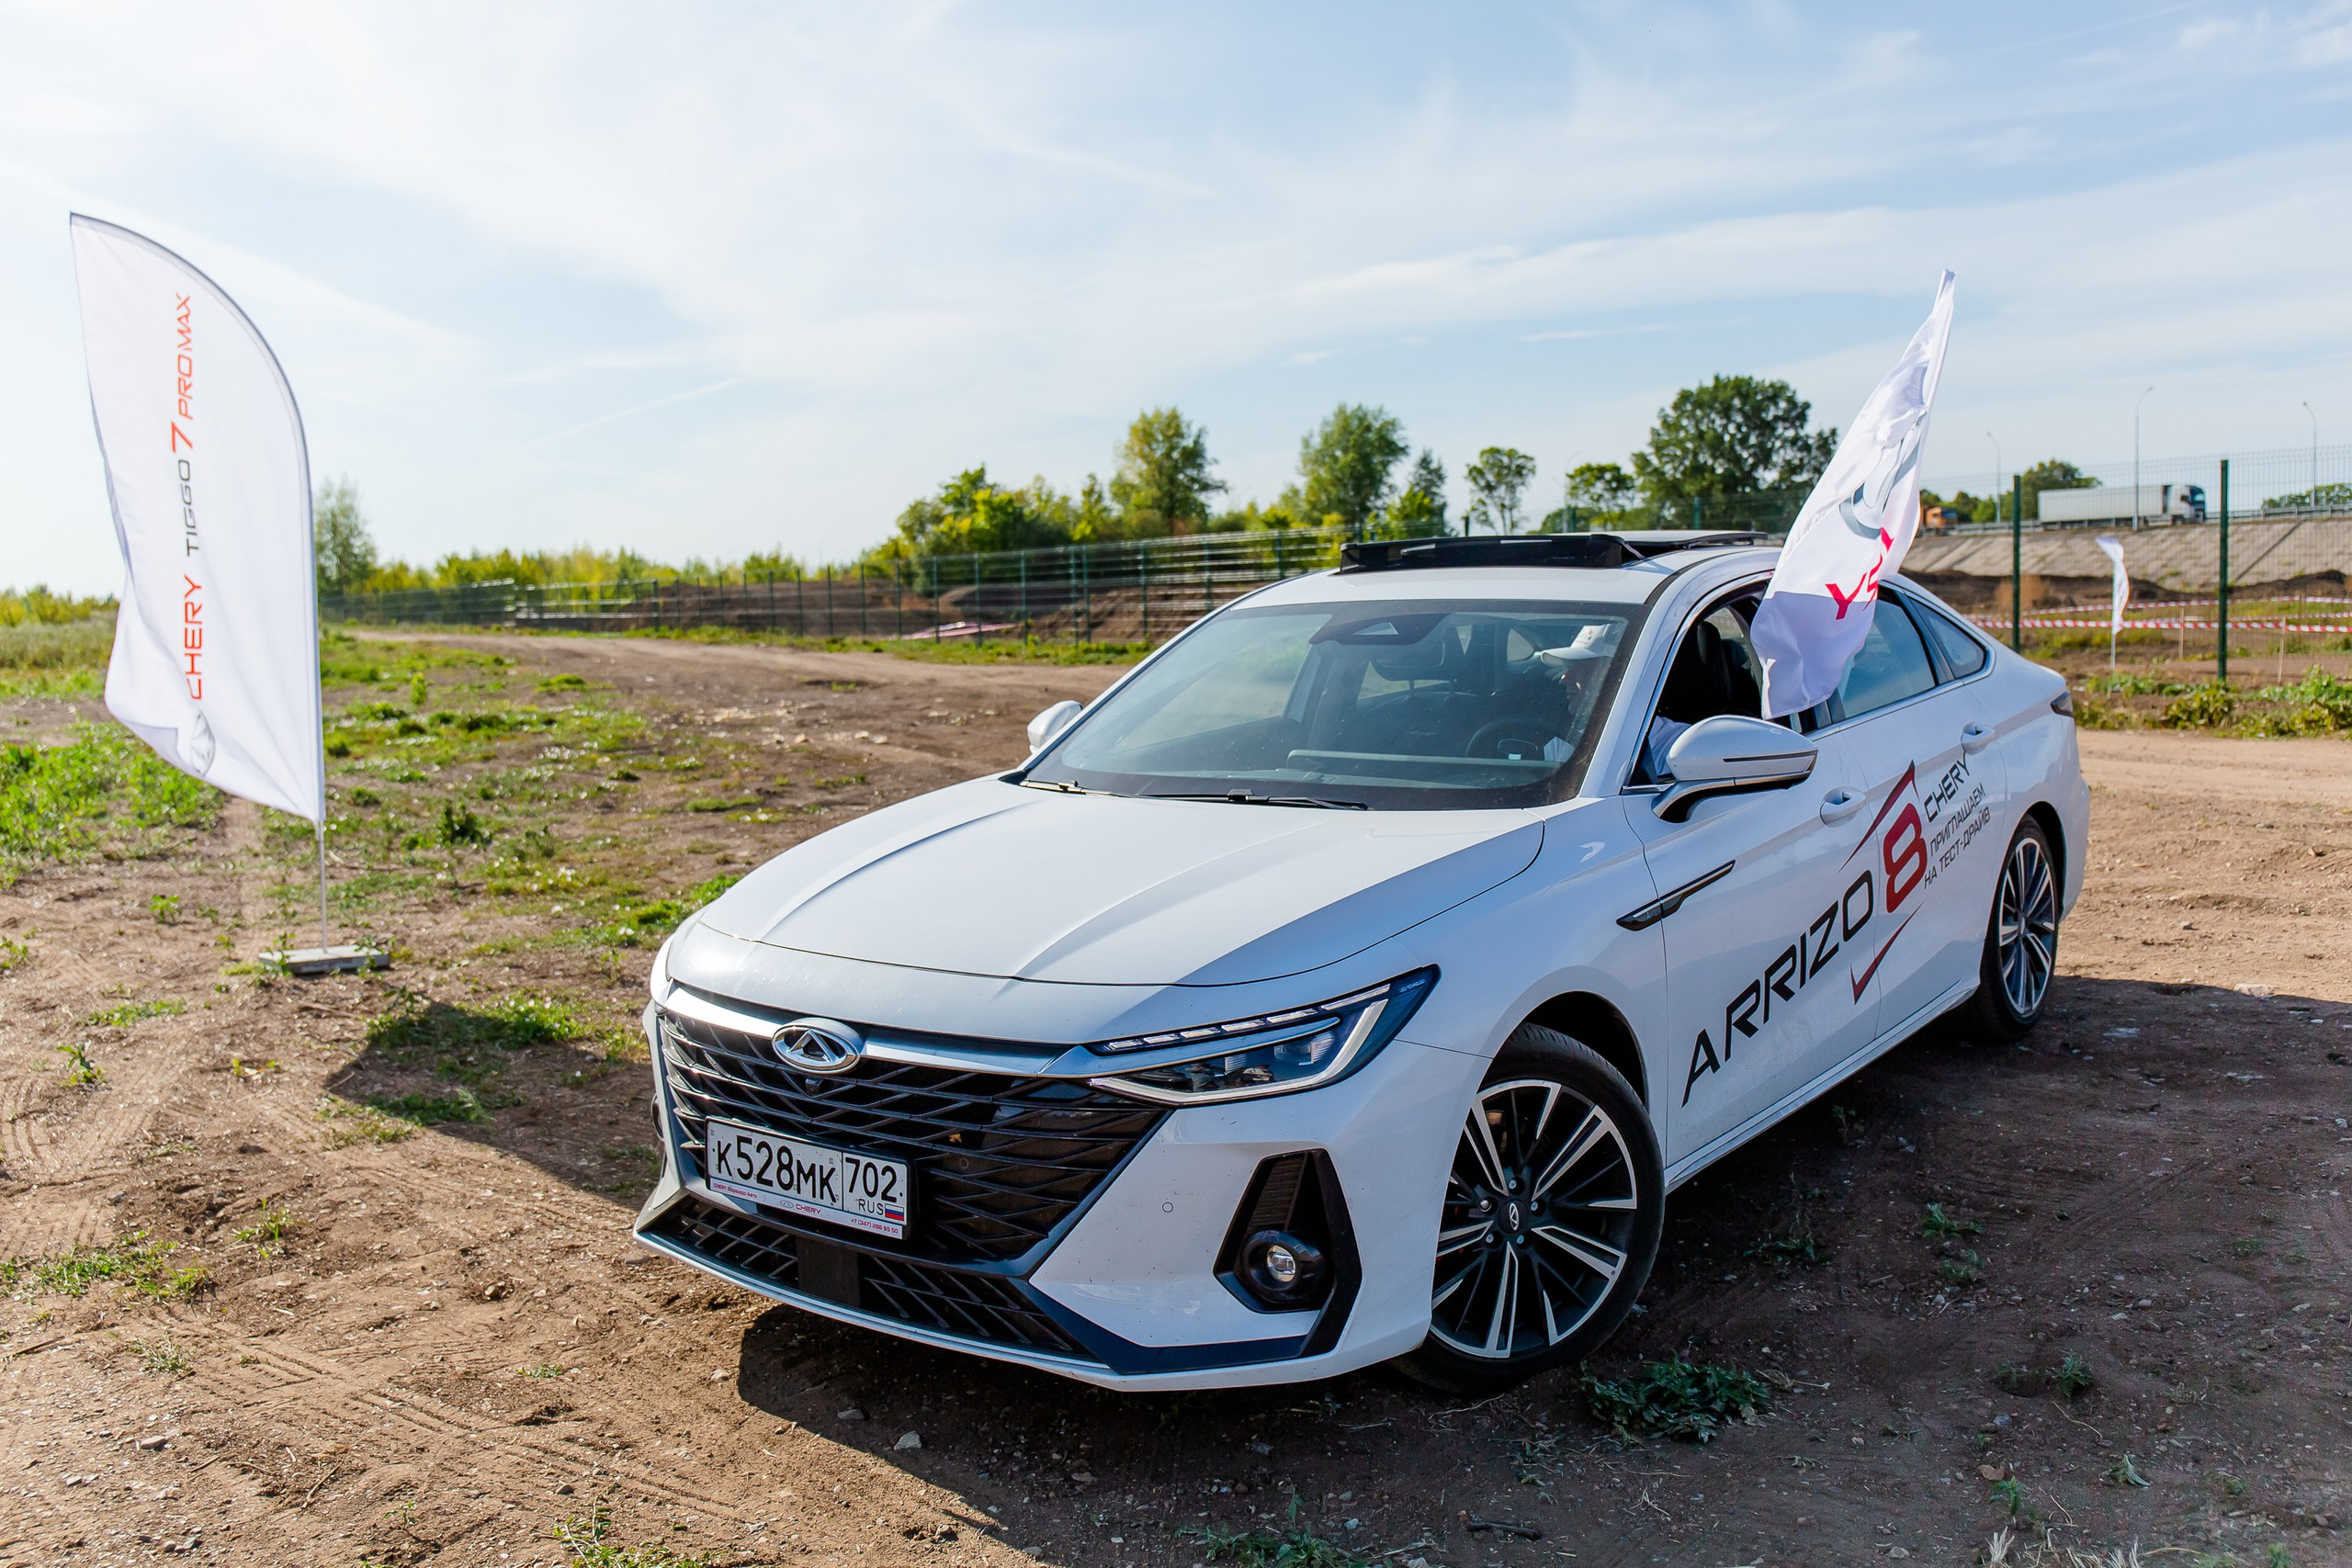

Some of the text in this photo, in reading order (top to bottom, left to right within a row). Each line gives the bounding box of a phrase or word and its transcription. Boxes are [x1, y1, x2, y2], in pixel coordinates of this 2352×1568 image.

[171, 420, 194, 454] 7
[178, 458, 199, 557] TIGGO
[184, 573, 203, 700] CHERY
[1924, 750, 1970, 823] CHERY
[1929, 782, 1986, 857] ПРИГЛАШАЕМ
[1924, 806, 1991, 889] НА ТЕСТ-ДРАЙВ
[1681, 801, 1928, 1109] ARRIZO 8
[795, 1203, 822, 1215] CHERY
[844, 1156, 898, 1203] 702
[858, 1198, 884, 1215] RUS
